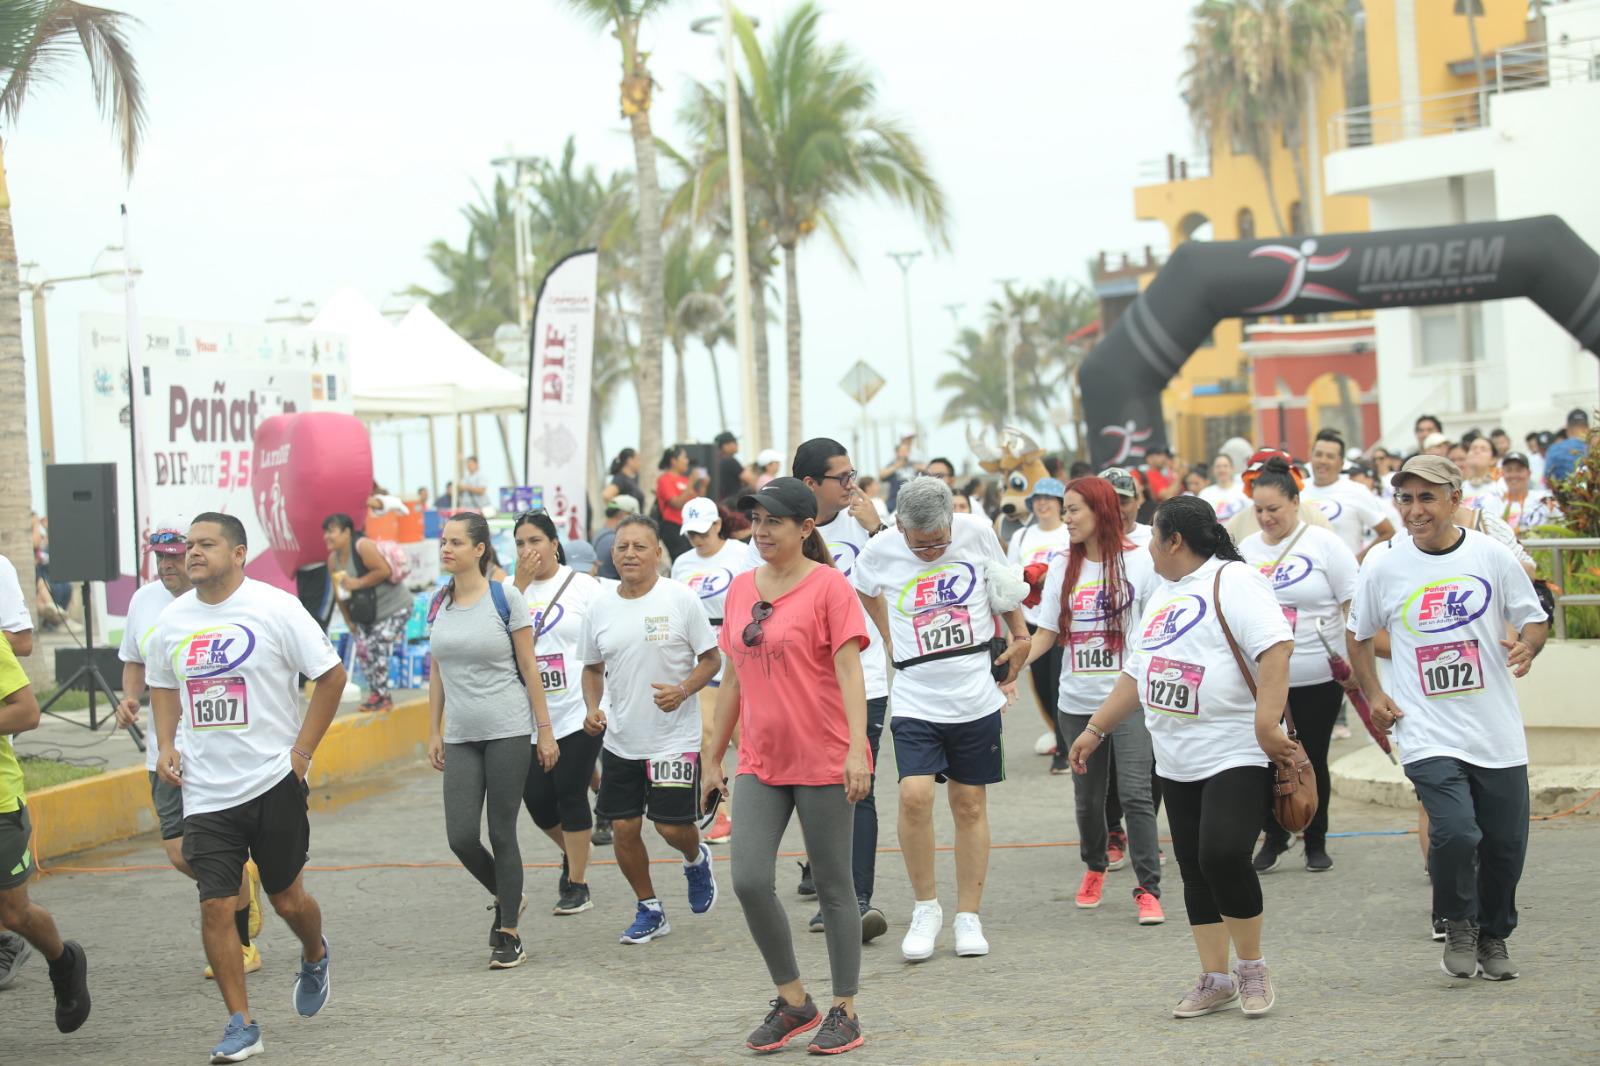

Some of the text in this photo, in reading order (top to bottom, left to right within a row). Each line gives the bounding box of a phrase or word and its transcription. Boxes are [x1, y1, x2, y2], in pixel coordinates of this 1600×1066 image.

[1358, 237, 1505, 282] IMDEM
[542, 324, 567, 402] DIF
[154, 451, 188, 486] DIF
[915, 575, 960, 607] 5K
[1418, 590, 1474, 620] 5K
[921, 623, 965, 651] 1275
[1143, 608, 1188, 638] 5K
[185, 638, 236, 666] 5K
[1075, 648, 1114, 669] 1148
[1424, 662, 1474, 691] 1072
[1150, 679, 1189, 709] 1279
[194, 698, 238, 723] 1307
[652, 761, 693, 780] 1038
